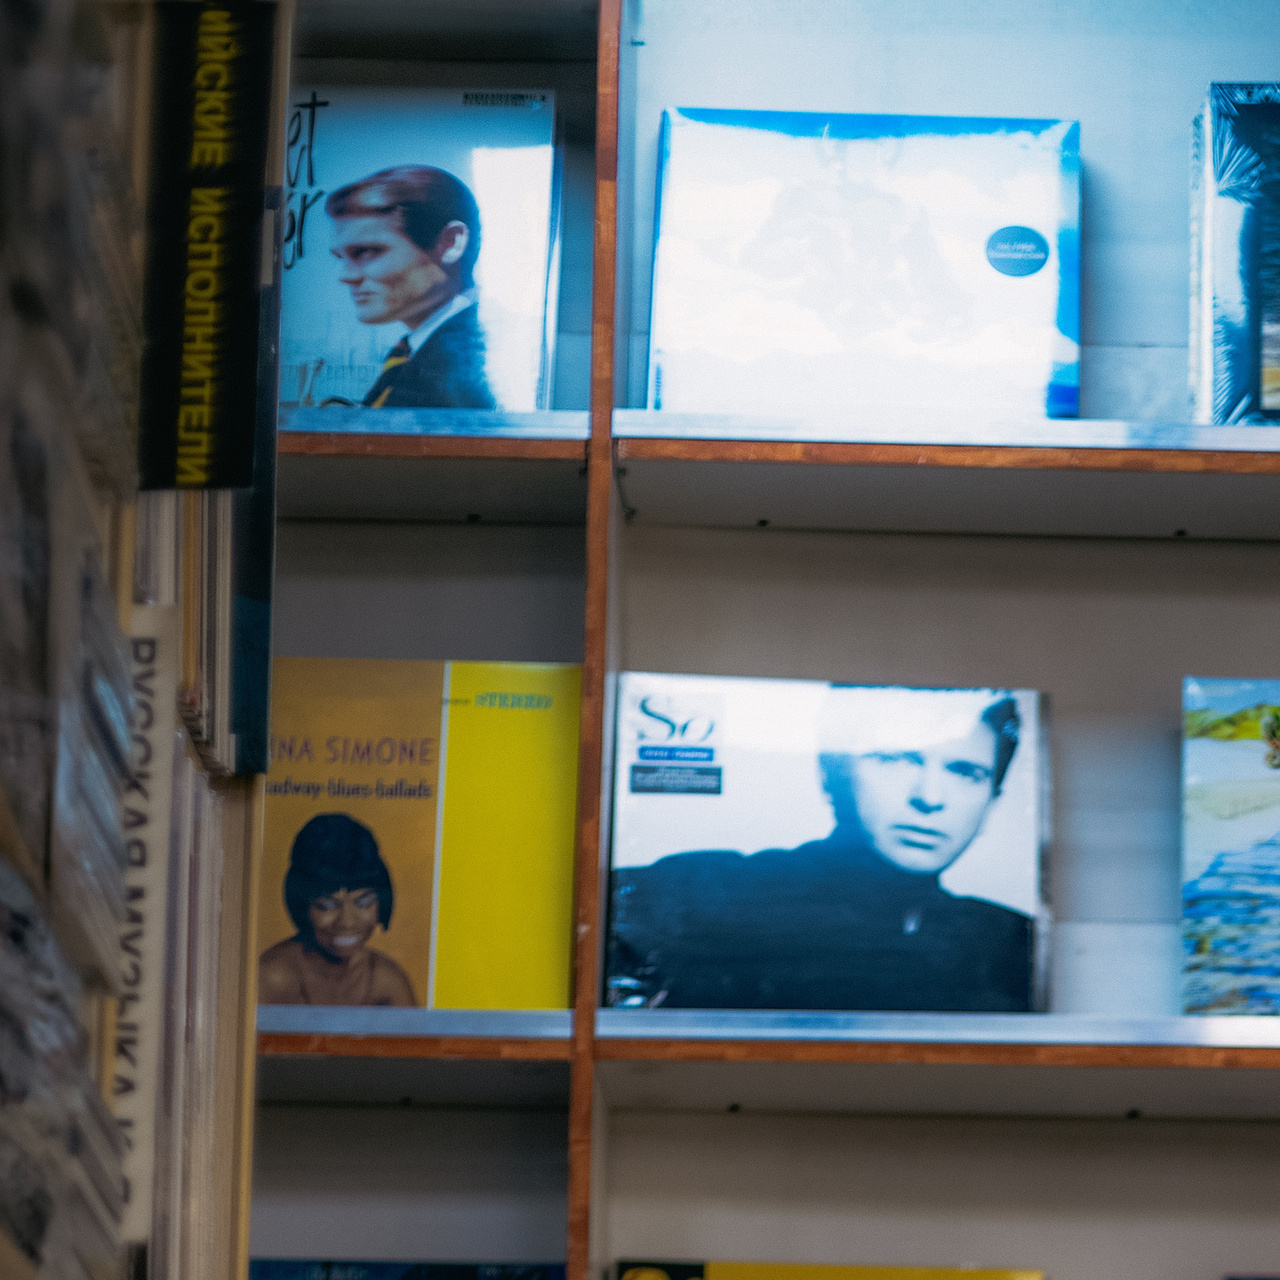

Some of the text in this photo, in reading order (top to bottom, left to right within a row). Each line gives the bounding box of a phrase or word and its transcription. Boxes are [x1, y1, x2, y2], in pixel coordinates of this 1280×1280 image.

[176, 8, 242, 485] ИЙСКИЕ ИСПОЛНИТЕЛИ
[270, 735, 434, 766] INA SIMONE
